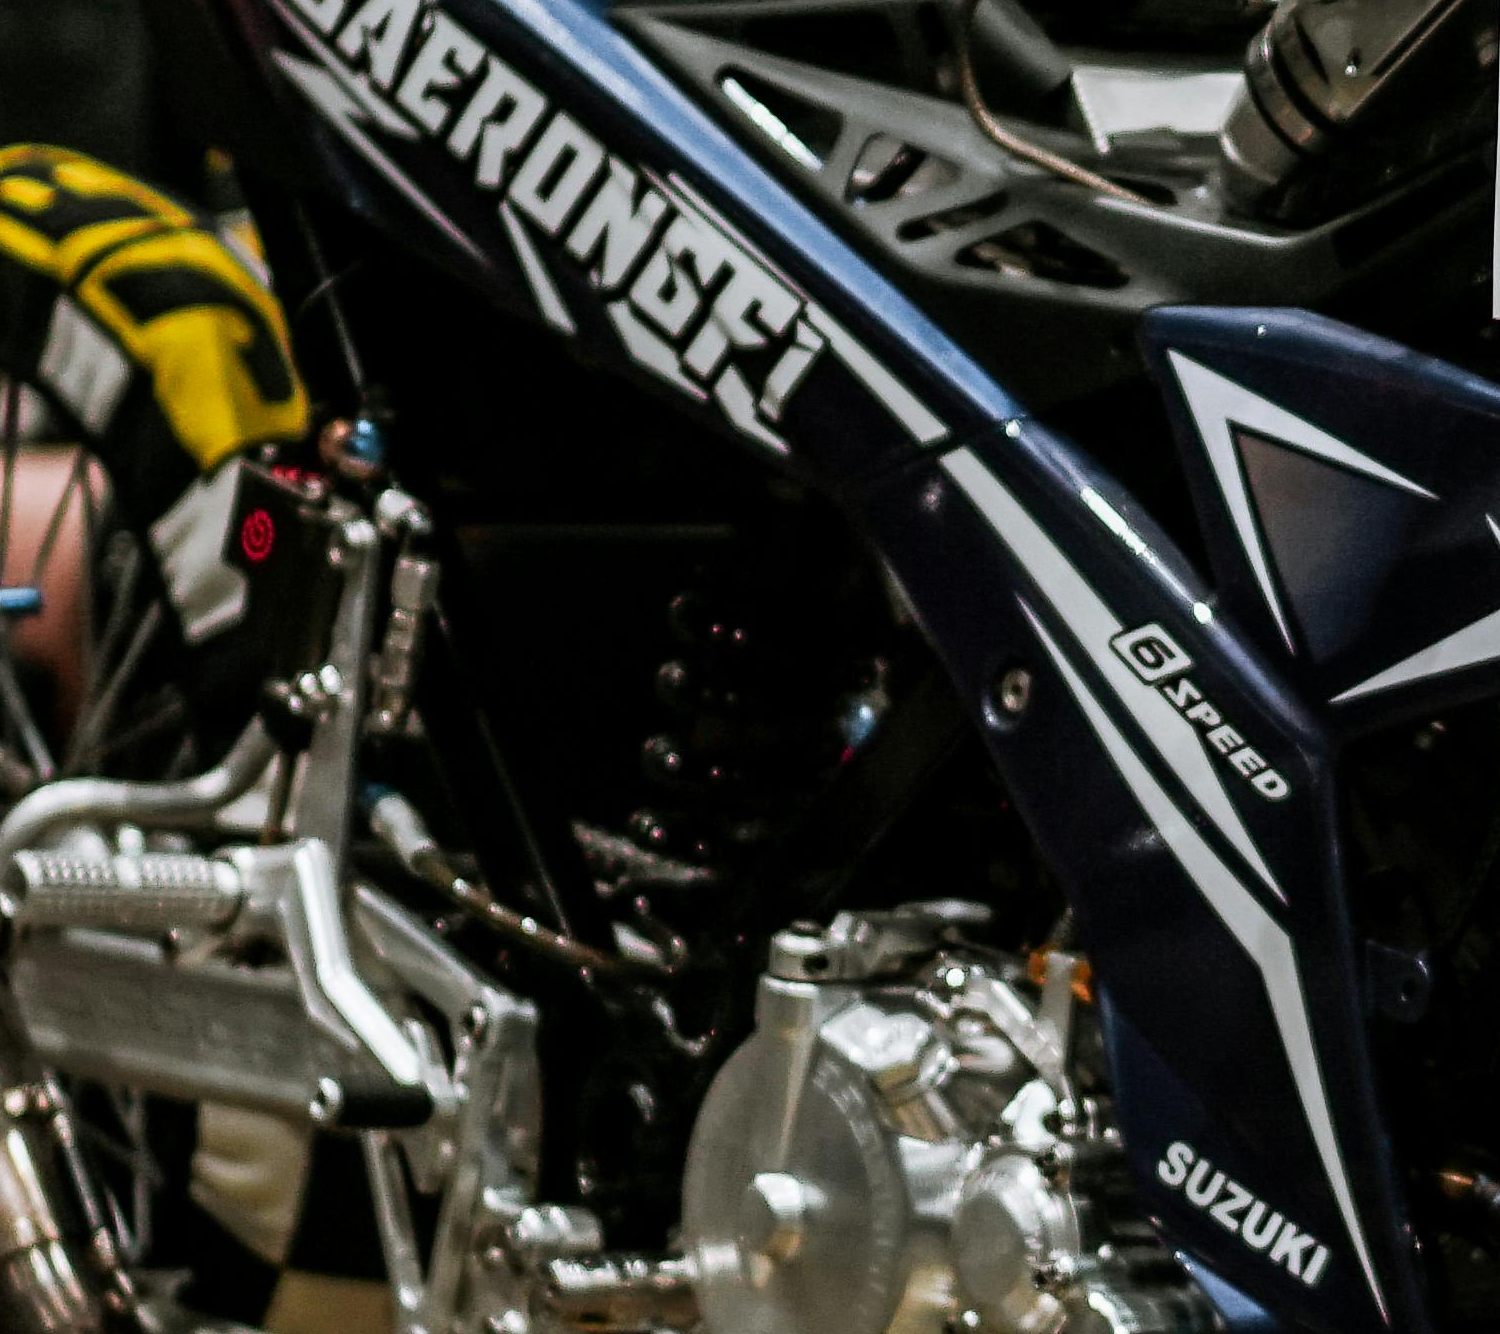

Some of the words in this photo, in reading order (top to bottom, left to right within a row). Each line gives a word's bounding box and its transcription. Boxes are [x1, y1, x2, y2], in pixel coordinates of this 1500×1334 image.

[1124, 628, 1182, 677] 6
[1163, 678, 1292, 802] SPEED
[1157, 1140, 1331, 1288] SUZUKI
